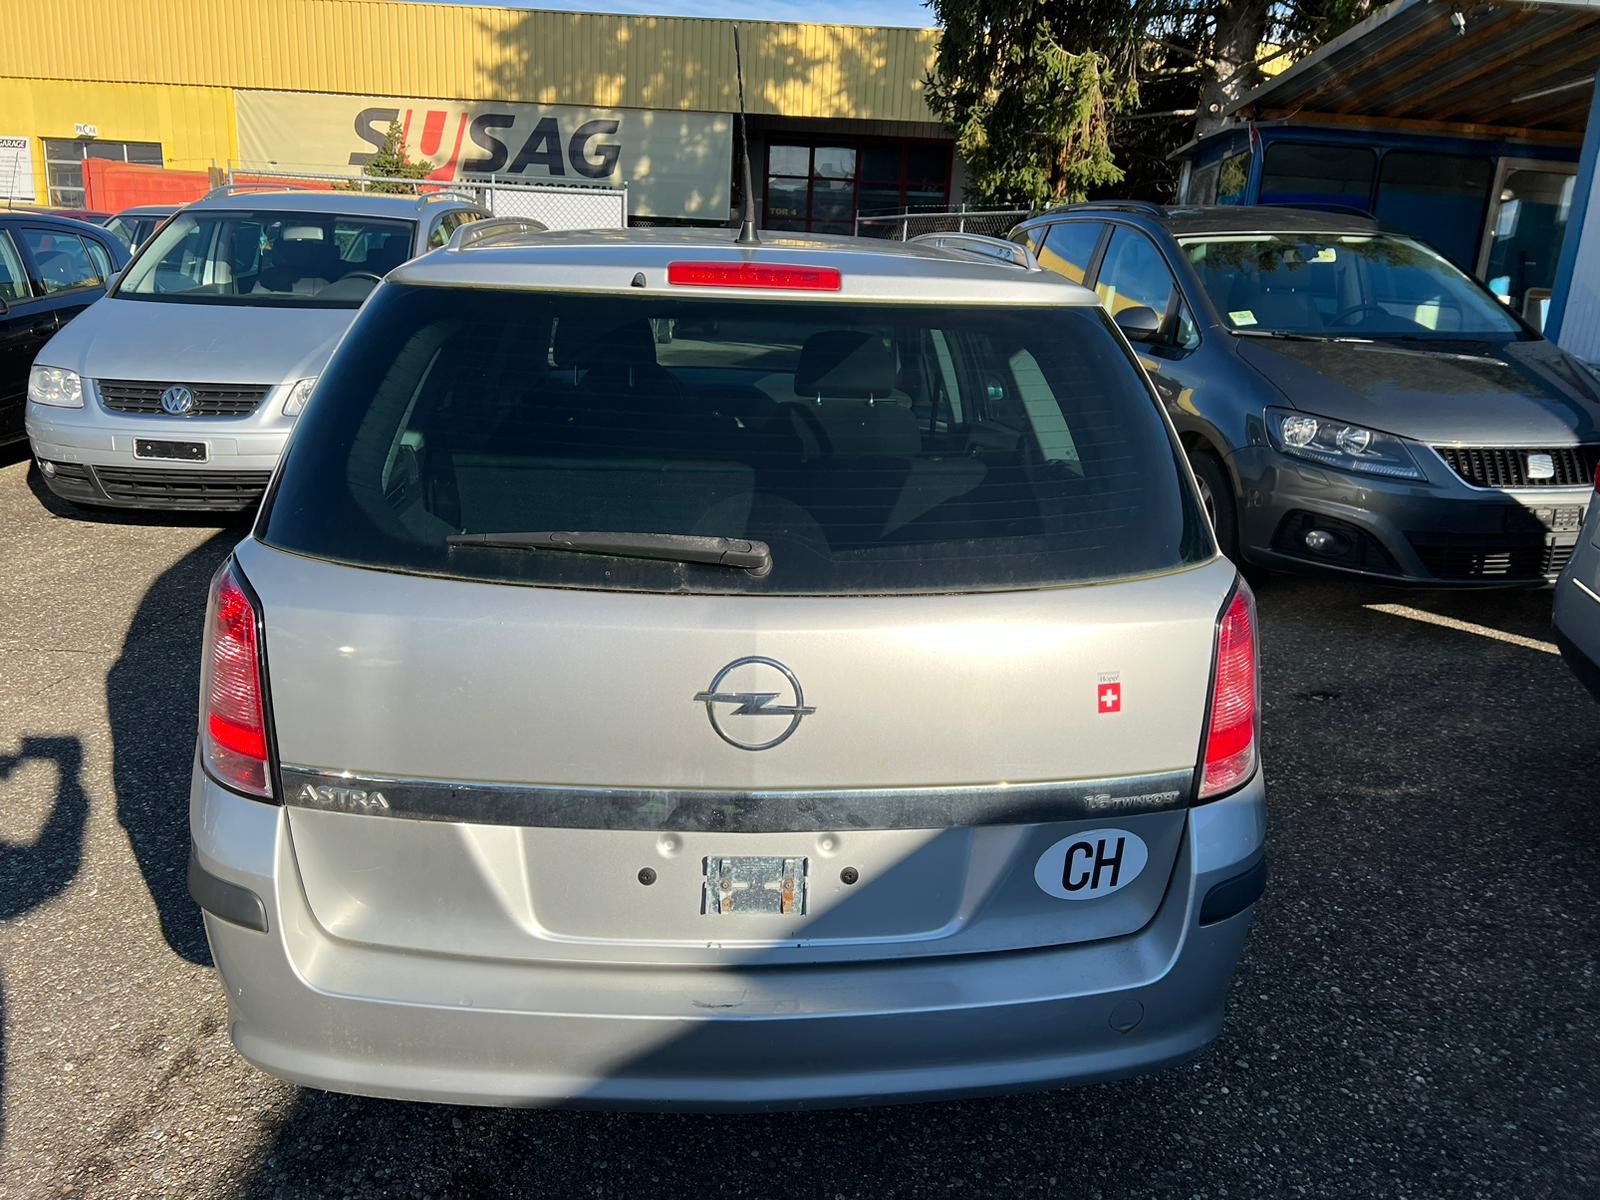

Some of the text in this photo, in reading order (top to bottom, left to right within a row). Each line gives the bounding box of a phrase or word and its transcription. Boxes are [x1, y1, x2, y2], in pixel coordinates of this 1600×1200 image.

[348, 107, 621, 187] SUSAG
[296, 783, 390, 808] ASTRA
[1062, 837, 1125, 891] CH
